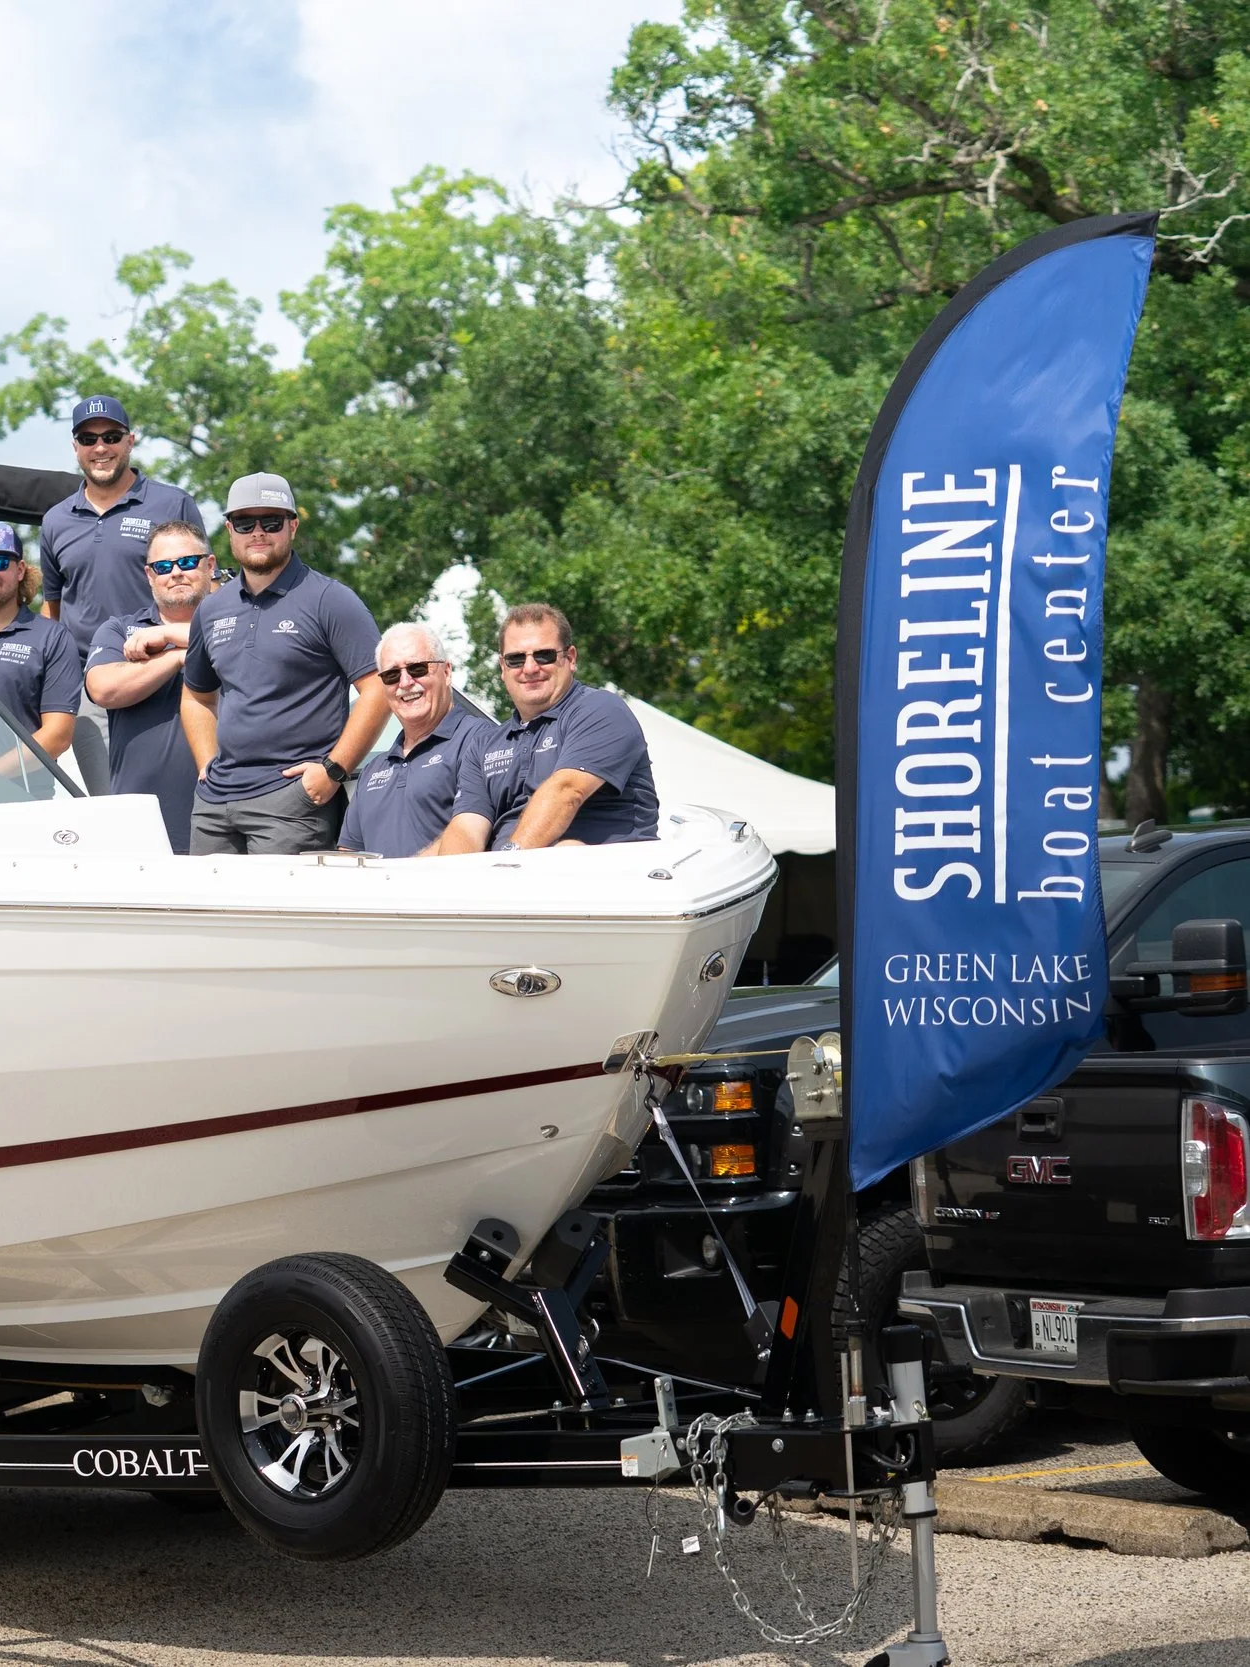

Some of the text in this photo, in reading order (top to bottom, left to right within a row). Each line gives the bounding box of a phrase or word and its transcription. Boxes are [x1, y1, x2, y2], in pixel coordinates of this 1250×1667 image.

[122, 517, 151, 528] SHORELINE
[214, 617, 237, 629] SHORELINE
[1, 643, 31, 654] SHORELINE
[894, 467, 998, 902] SHORELINE
[1017, 465, 1099, 903] boat center
[485, 748, 514, 762] SHORELINE
[884, 953, 1092, 984] GREEN LAKE
[882, 991, 1091, 1027] WISCONSIN
[1007, 1156, 1070, 1184] GMC
[1031, 1302, 1062, 1311] WISCONSIN
[1035, 1322, 1040, 1336] B
[72, 1448, 202, 1477] COBALT
